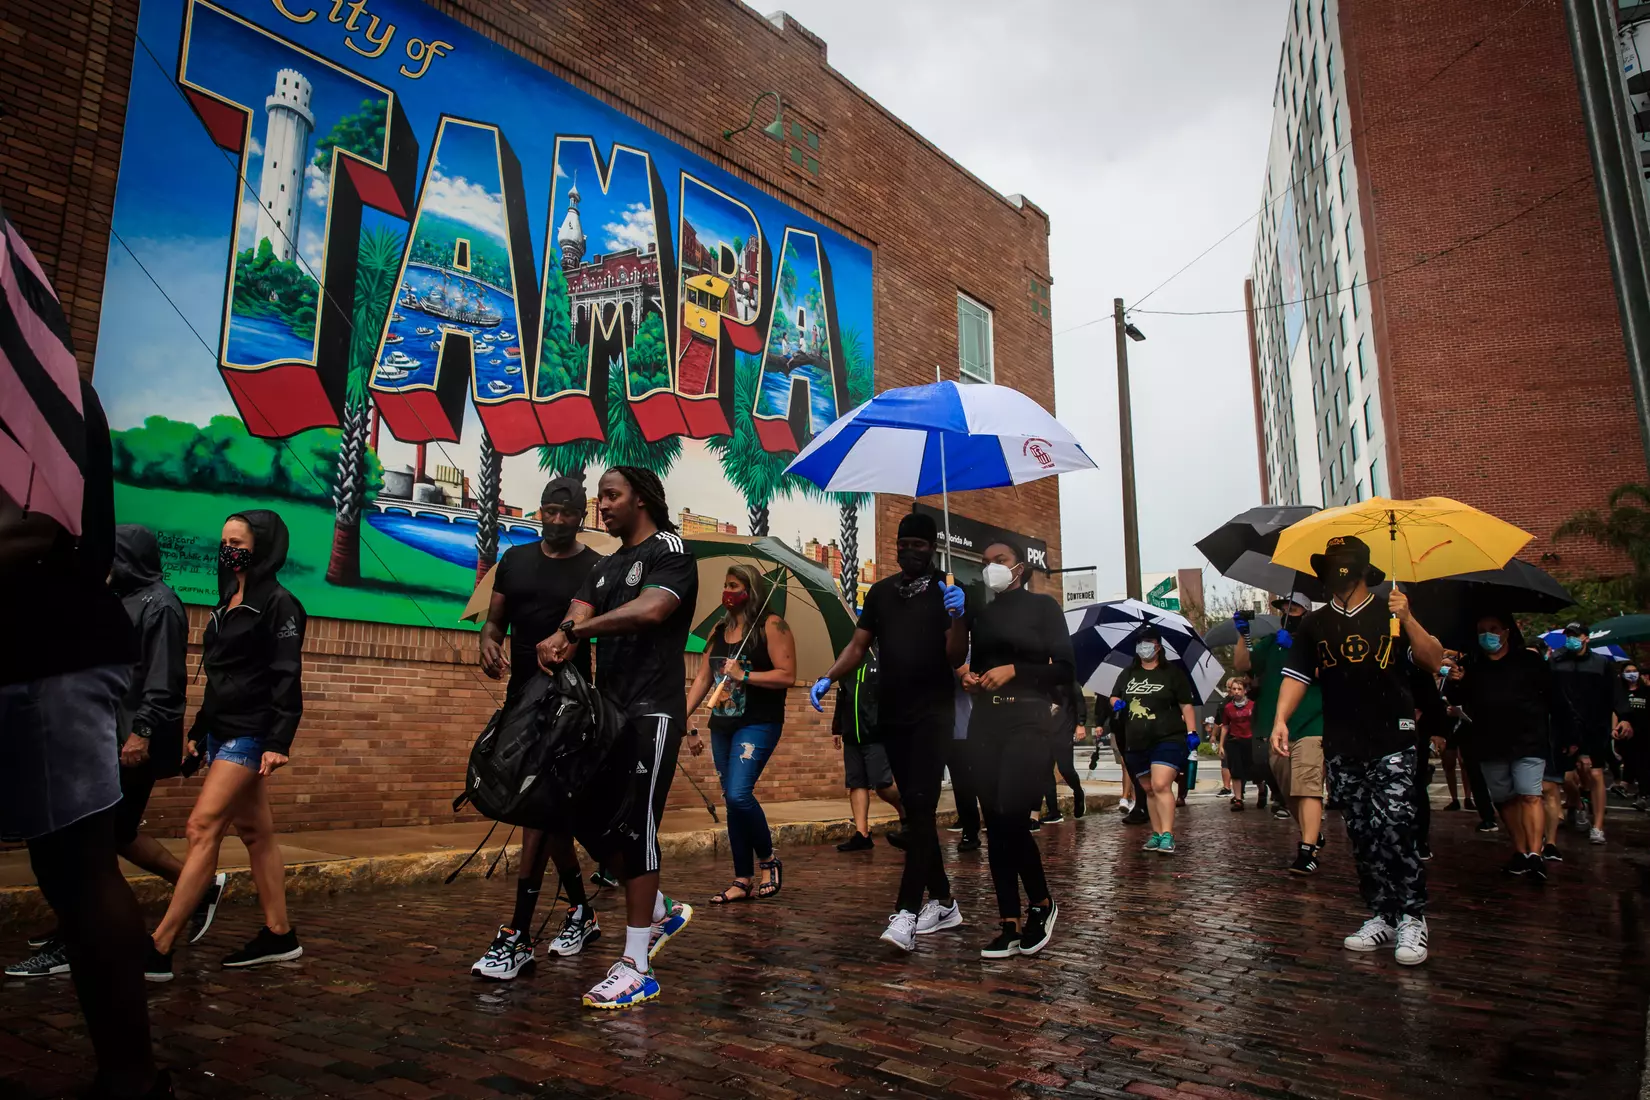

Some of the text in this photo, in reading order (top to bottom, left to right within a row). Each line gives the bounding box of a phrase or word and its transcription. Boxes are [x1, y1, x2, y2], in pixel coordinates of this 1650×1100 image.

[400, 38, 455, 80] of
[178, 0, 840, 440] TAMPA
[937, 532, 973, 547] rth lorida Ave
[180, 551, 202, 560] Public
[203, 554, 217, 563] Art
[1027, 547, 1047, 569] PPK
[1066, 590, 1095, 602] CONTENDER
